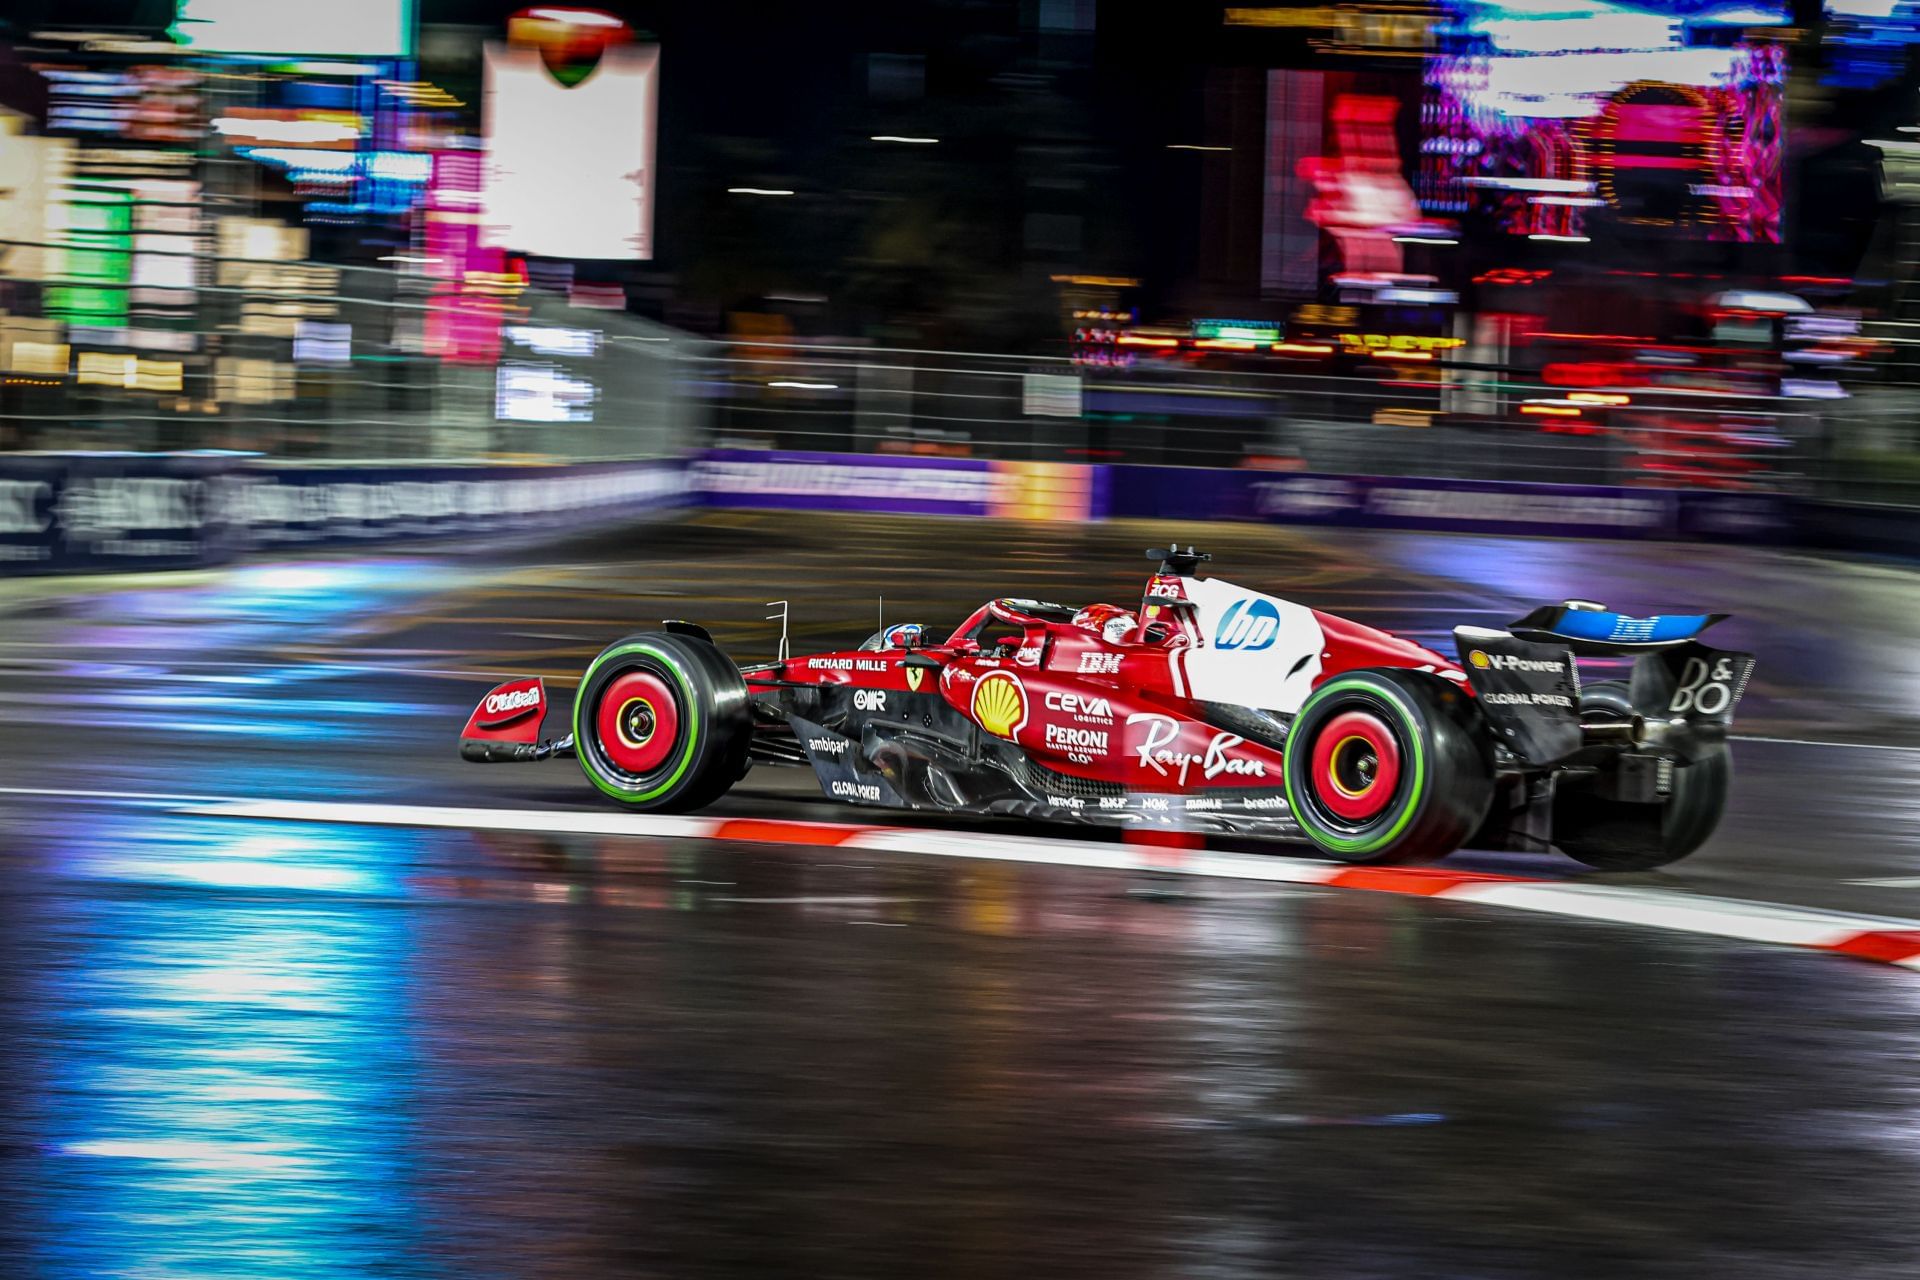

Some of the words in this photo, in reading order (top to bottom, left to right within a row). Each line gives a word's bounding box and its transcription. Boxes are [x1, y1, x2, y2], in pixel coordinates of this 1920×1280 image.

[1217, 598, 1280, 650] hp
[808, 658, 853, 670] RICHARD
[856, 660, 887, 672] MILLE
[1077, 651, 1125, 674] IBM
[1487, 654, 1566, 674] V-Power
[1483, 693, 1533, 705] GLOBAL
[1073, 714, 1114, 726] LOGISTICS
[1045, 723, 1109, 749] PERONI
[808, 736, 845, 756] ambipar
[857, 784, 881, 801] POKER
[1142, 798, 1169, 811] NGK
